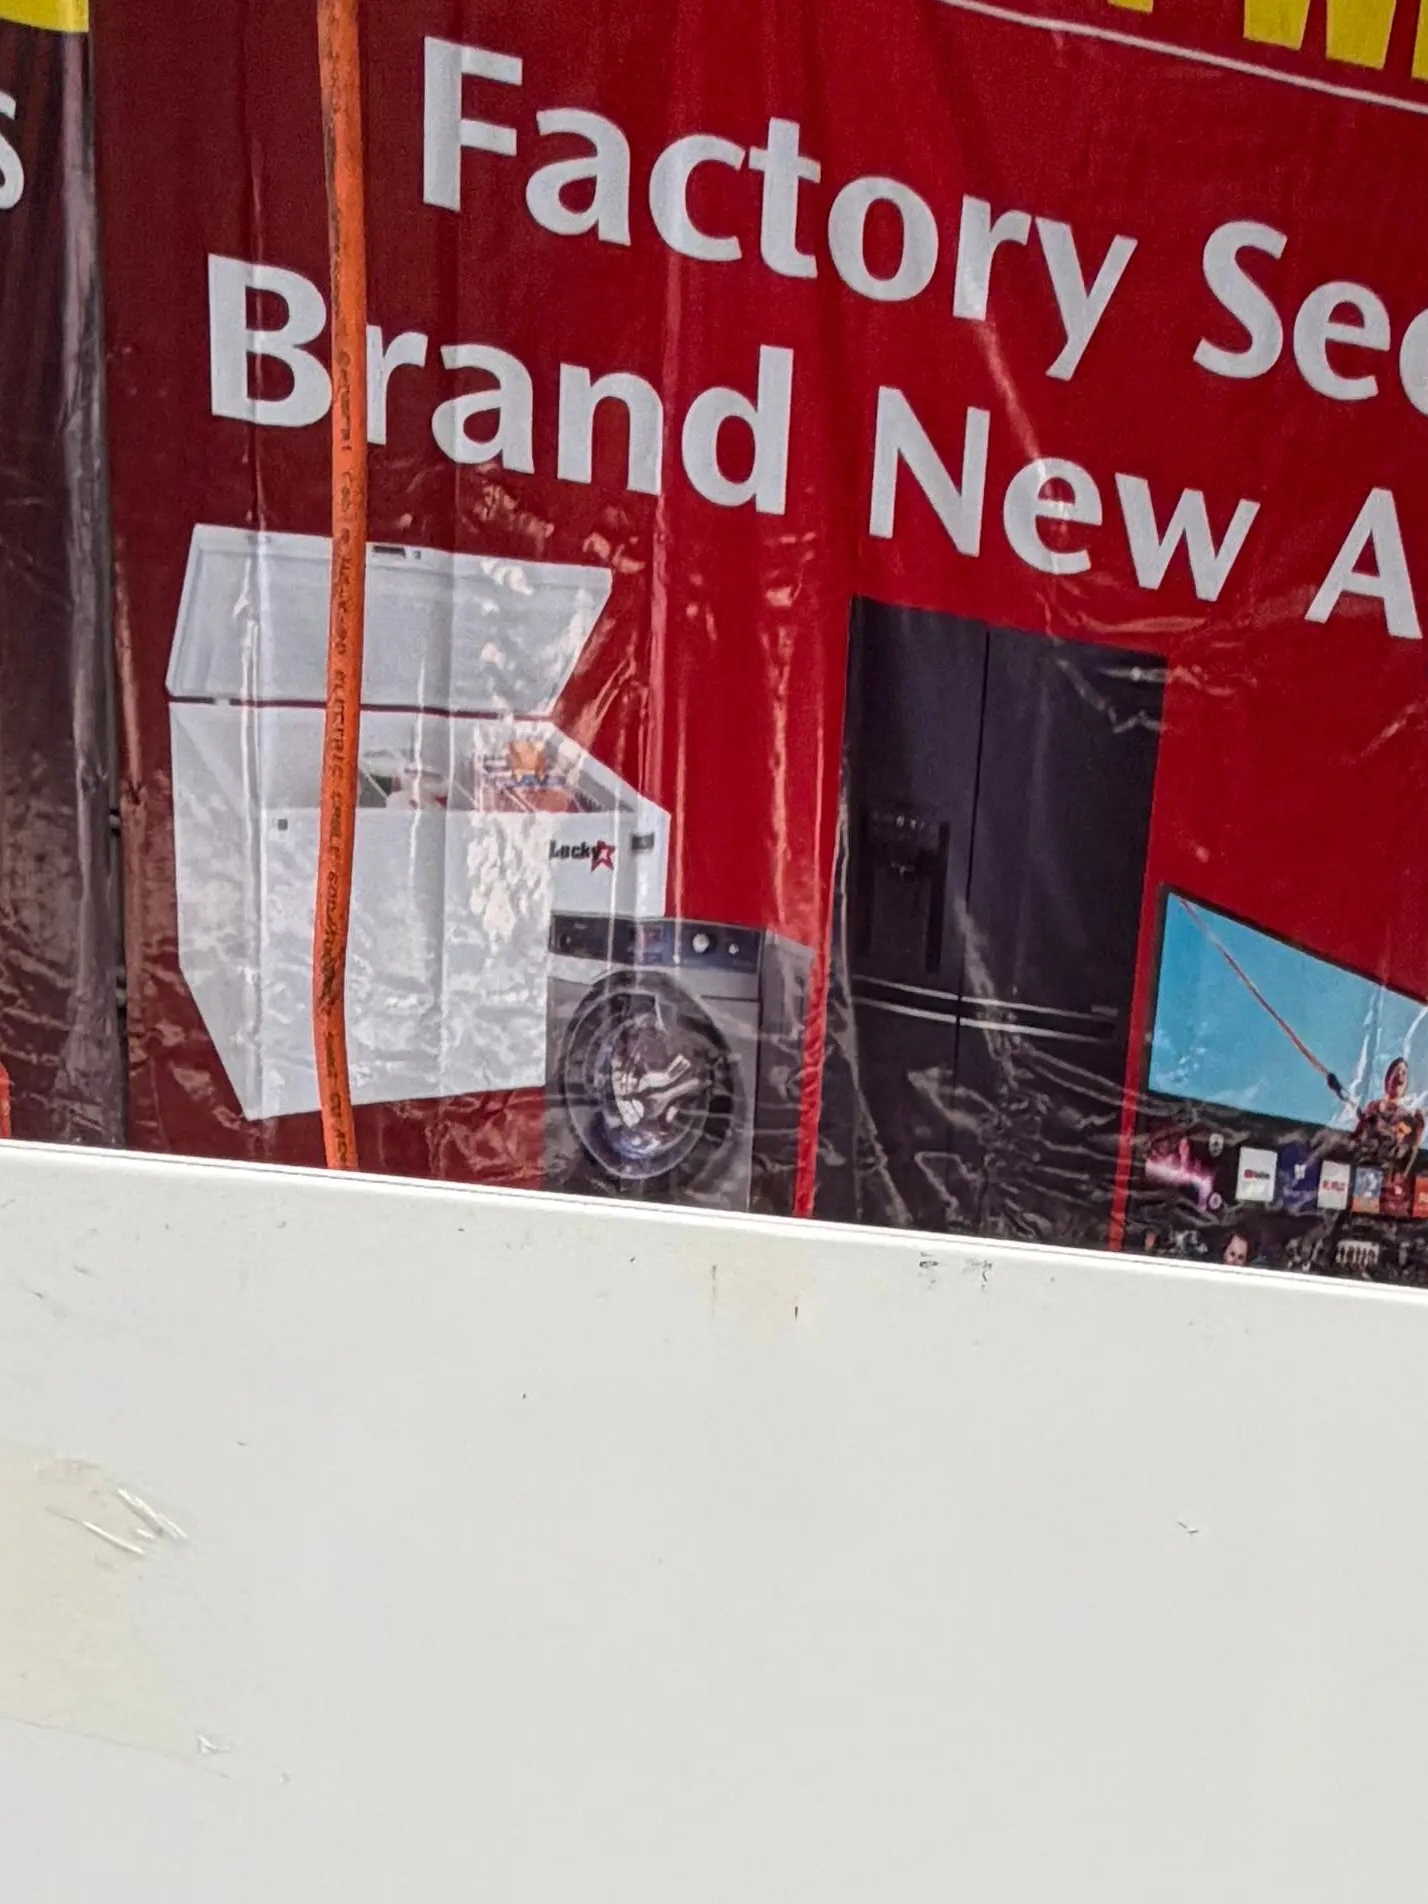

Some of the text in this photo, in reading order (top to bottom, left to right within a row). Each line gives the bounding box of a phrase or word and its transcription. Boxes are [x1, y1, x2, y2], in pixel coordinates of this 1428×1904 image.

[422, 36, 1139, 383] Factory
[206, 252, 796, 517] Brand
[868, 385, 1261, 604] New
